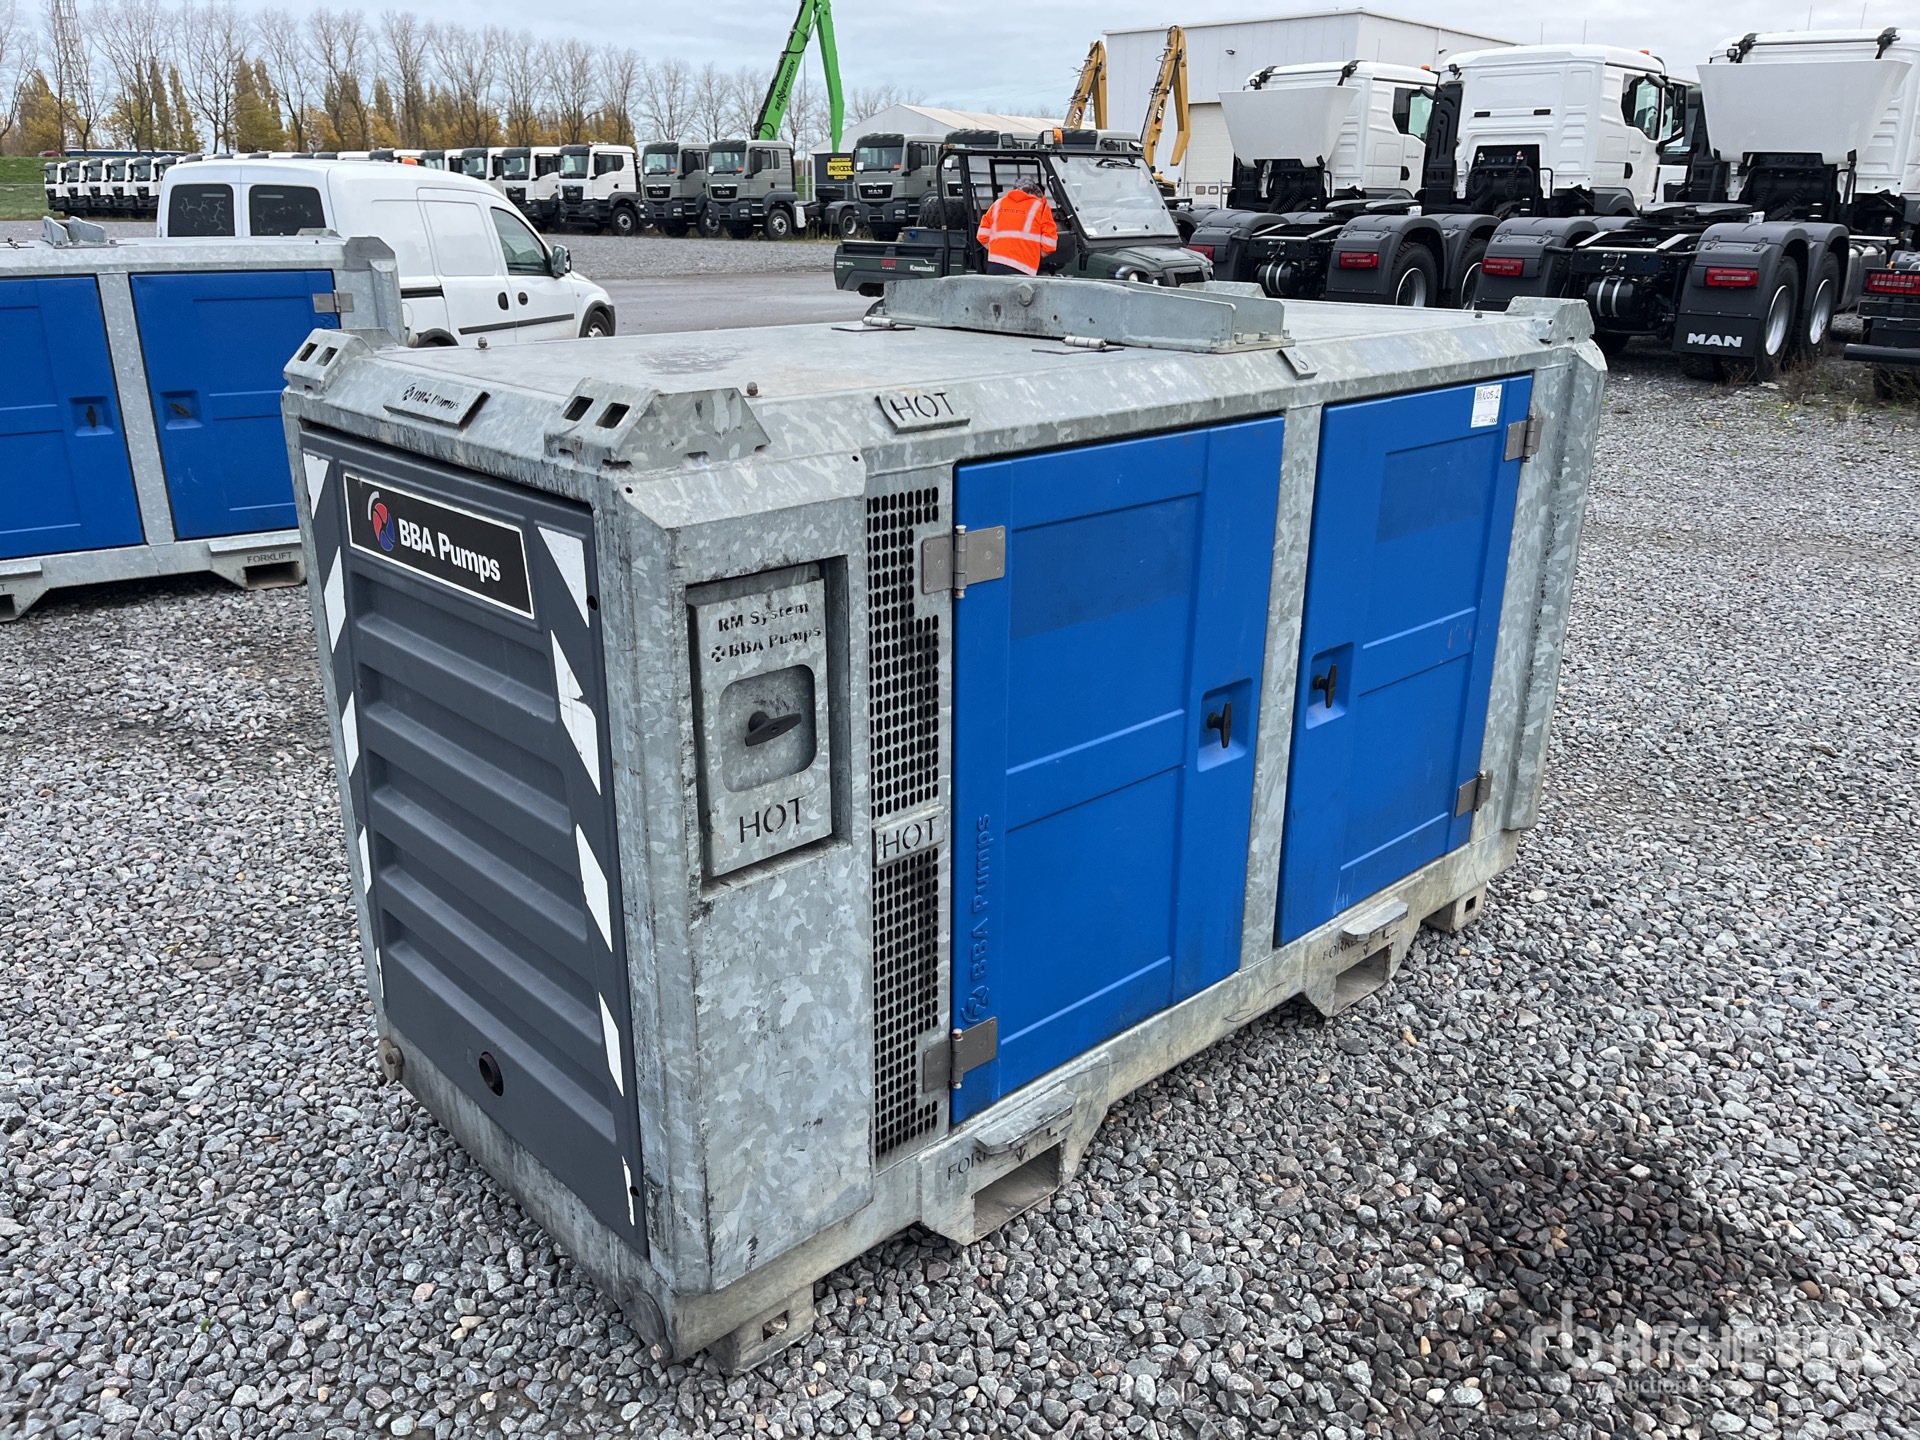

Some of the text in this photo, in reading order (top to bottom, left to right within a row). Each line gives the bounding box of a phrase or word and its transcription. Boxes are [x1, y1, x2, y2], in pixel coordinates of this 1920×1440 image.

[775, 59, 795, 111] SENNEBOGEN
[909, 264, 935, 272] Kawasaki
[1687, 333, 1742, 348] MAN
[889, 392, 955, 421] HOT
[246, 551, 293, 563] FORKLIFT
[398, 518, 501, 583] BBA Pumps
[718, 603, 809, 632] RM System
[729, 627, 821, 658] BBA Pumps
[739, 796, 806, 843] HOT
[882, 816, 939, 859] HOT
[971, 814, 994, 981] BBA Pumps
